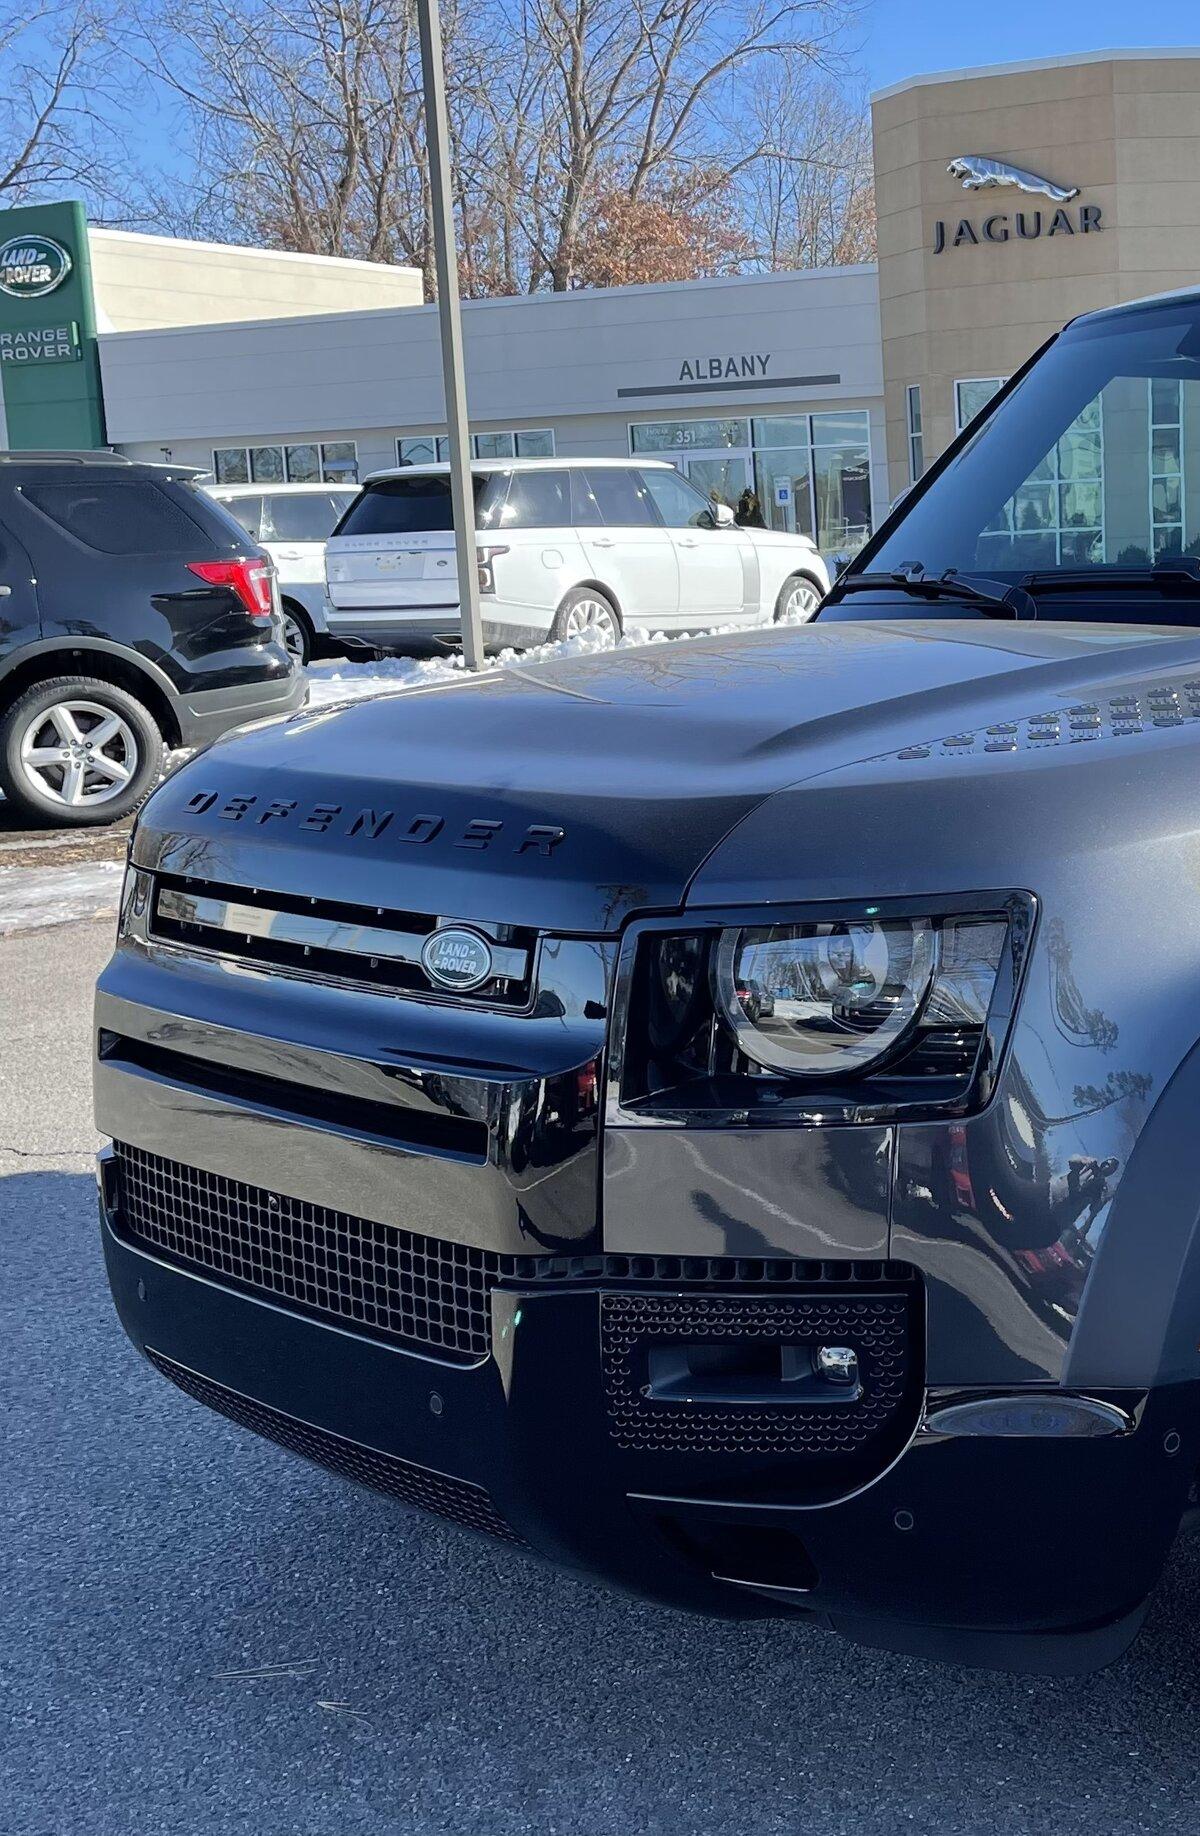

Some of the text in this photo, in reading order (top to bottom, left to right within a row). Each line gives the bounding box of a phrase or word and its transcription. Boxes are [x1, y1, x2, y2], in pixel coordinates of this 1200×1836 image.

[933, 205, 1103, 254] JAGUAR
[1, 248, 37, 266] LAND
[6, 265, 51, 283] ROVER
[0, 328, 68, 345] RANGE
[1, 345, 71, 361] ROVER
[679, 354, 771, 381] ALBANY
[676, 431, 696, 444] 351
[181, 789, 565, 856] DEFENDER
[439, 942, 469, 957] LAND
[440, 957, 476, 973] ROVER
